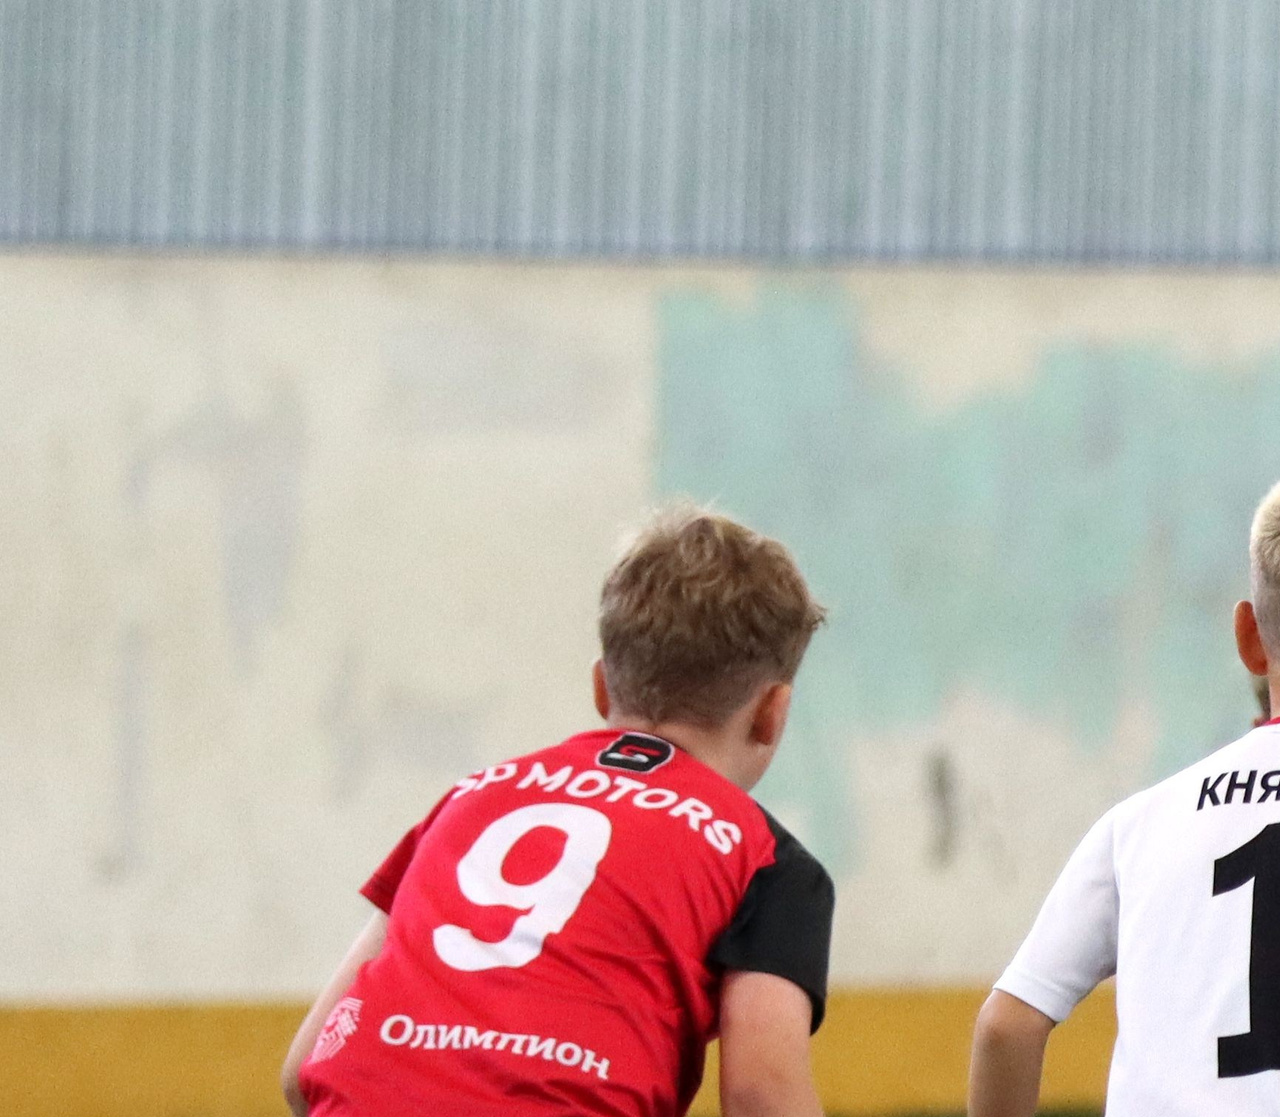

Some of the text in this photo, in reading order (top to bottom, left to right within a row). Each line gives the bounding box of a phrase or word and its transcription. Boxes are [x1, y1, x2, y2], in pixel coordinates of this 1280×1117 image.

[516, 761, 743, 855] MOTORS
[433, 802, 612, 971] 9
[379, 1014, 610, 1080] Олимпион
